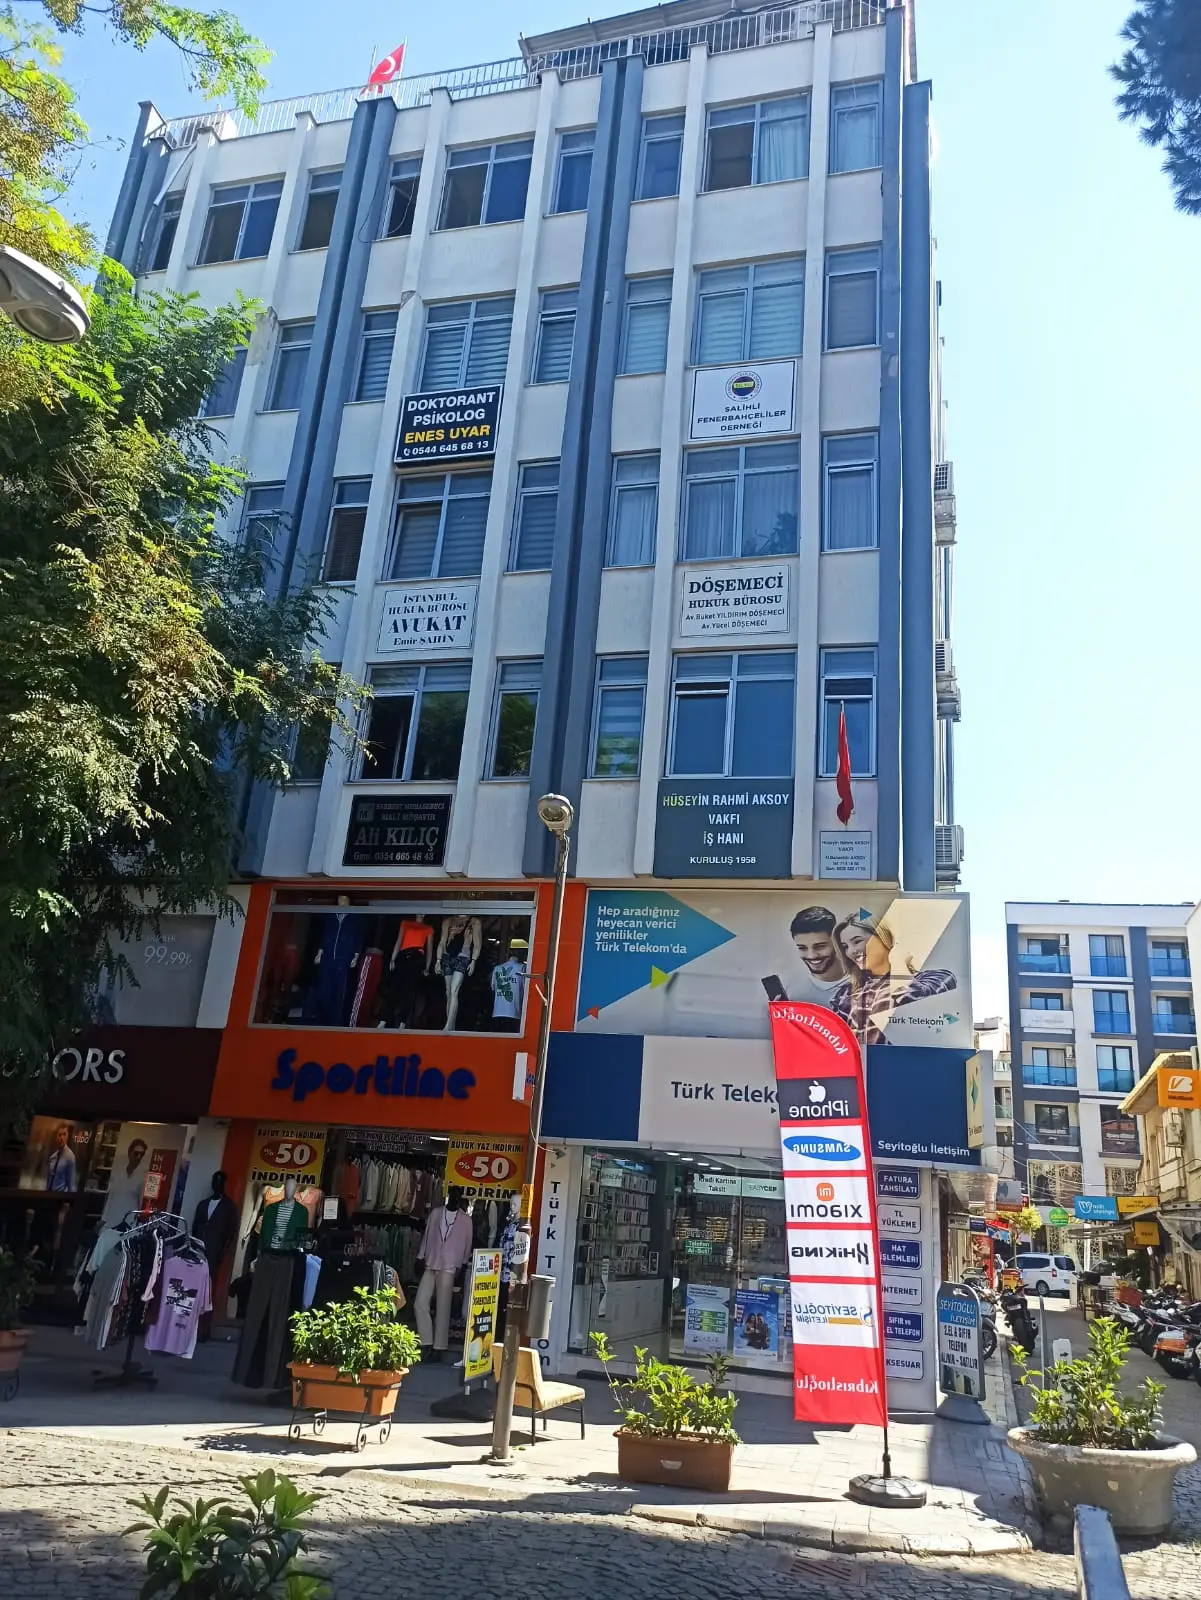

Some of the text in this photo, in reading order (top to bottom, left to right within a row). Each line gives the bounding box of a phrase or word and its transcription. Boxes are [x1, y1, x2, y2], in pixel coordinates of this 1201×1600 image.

[407, 391, 496, 412] DOKTORANT
[724, 402, 761, 413] SALİHLİ
[412, 408, 486, 427] PSİKOLOG
[697, 409, 787, 424] FENERBAHÇELİLER
[720, 421, 762, 432] DERNEĞİ
[404, 424, 491, 445] ENES UYAR
[412, 440, 489, 456] 0544 645 68 13
[688, 572, 783, 596] DÖŞEMECİ
[688, 594, 783, 609] HUKUK BÜROSU
[388, 602, 469, 616] HUKUK BÜROSU
[387, 615, 466, 634] AVUKAT
[393, 637, 418, 647] Emir
[663, 791, 789, 807] HÜSEYİN RAHMİ AKSOY
[708, 813, 740, 825] VAKFI
[352, 826, 439, 852] Ali KILIÇ
[703, 831, 744, 847] İŞ HANI
[689, 856, 756, 866] KURULUŞ 1958
[597, 906, 680, 921] Hep aradığınız
[596, 918, 677, 931] heyecan verici
[595, 930, 648, 943] yenilikler
[594, 941, 687, 955] Türk Telekom'da
[887, 1016, 944, 1027] Türk Telekom
[271, 1047, 476, 1102] Sportline
[670, 1081, 779, 1104] Türk Telek
[477, 1142, 491, 1152] YAZ
[878, 1138, 970, 1157] Seyitoğlu İletişim
[883, 1175, 913, 1185] FATURA
[879, 1184, 918, 1195] TAHSİLATI
[894, 1210, 904, 1218] TL
[881, 1216, 917, 1229] YÜKLEME
[891, 1244, 906, 1252] HAT
[940, 1299, 976, 1315] SEYİTOĞLU
[894, 1327, 921, 1337] TELEFON
[885, 1358, 921, 1370] KSESUAR
